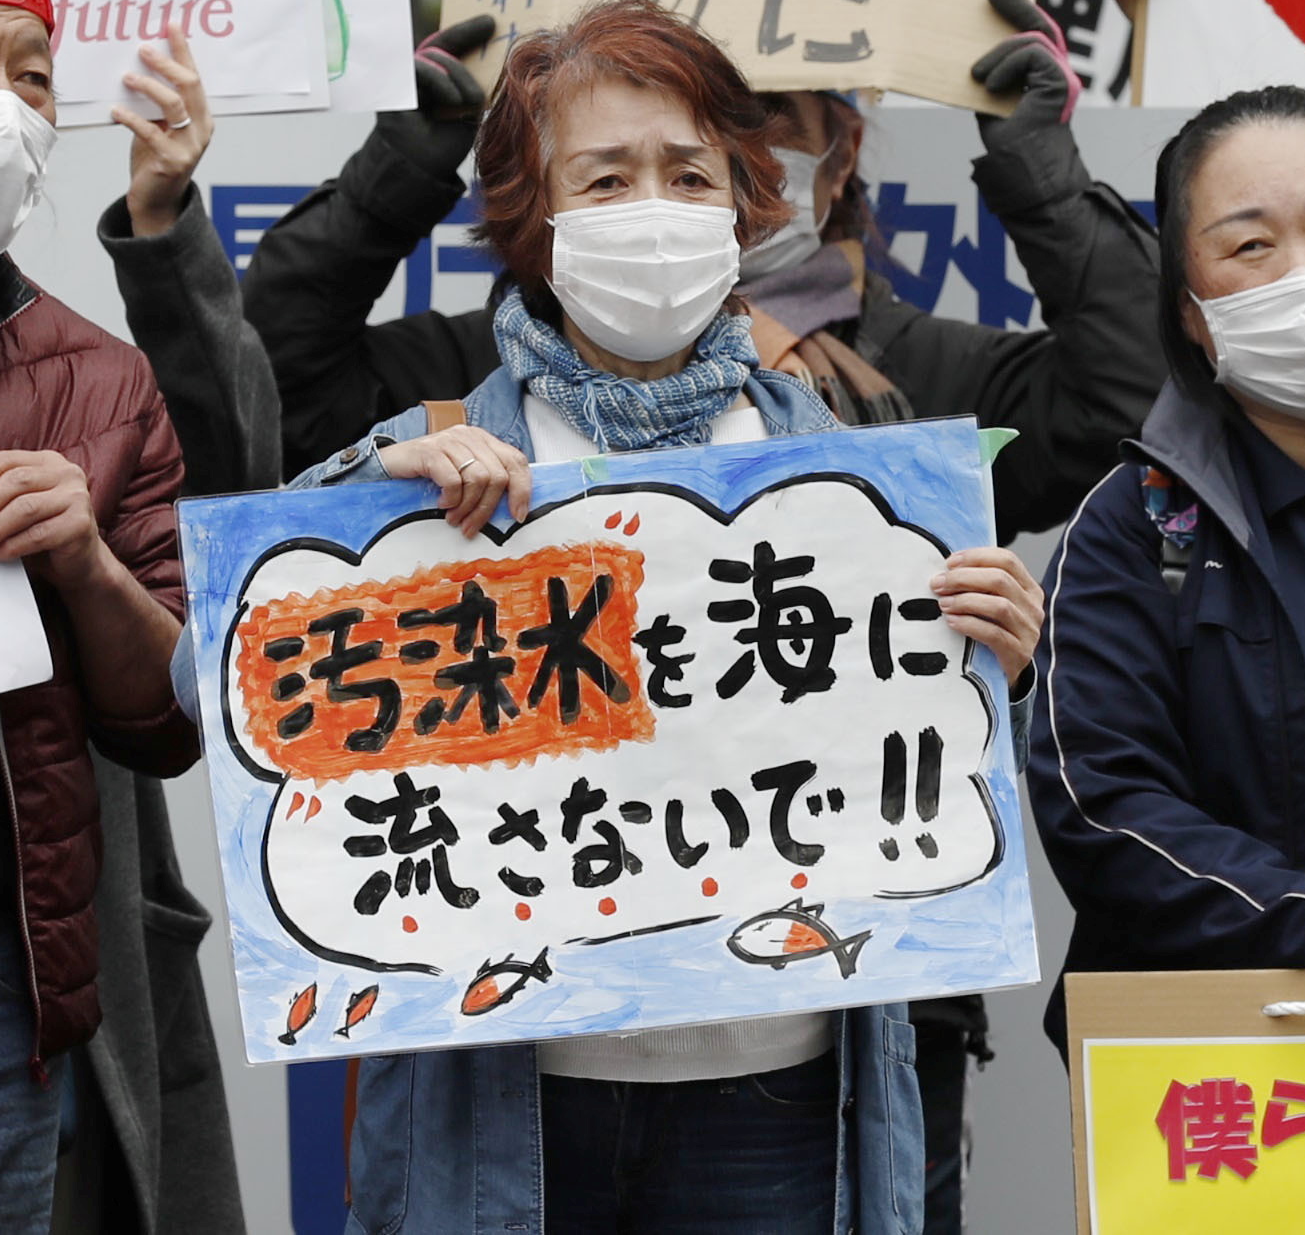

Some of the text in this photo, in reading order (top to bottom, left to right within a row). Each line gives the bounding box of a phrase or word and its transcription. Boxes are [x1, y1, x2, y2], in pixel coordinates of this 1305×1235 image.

[263, 539, 951, 754] 汚染水を海に
